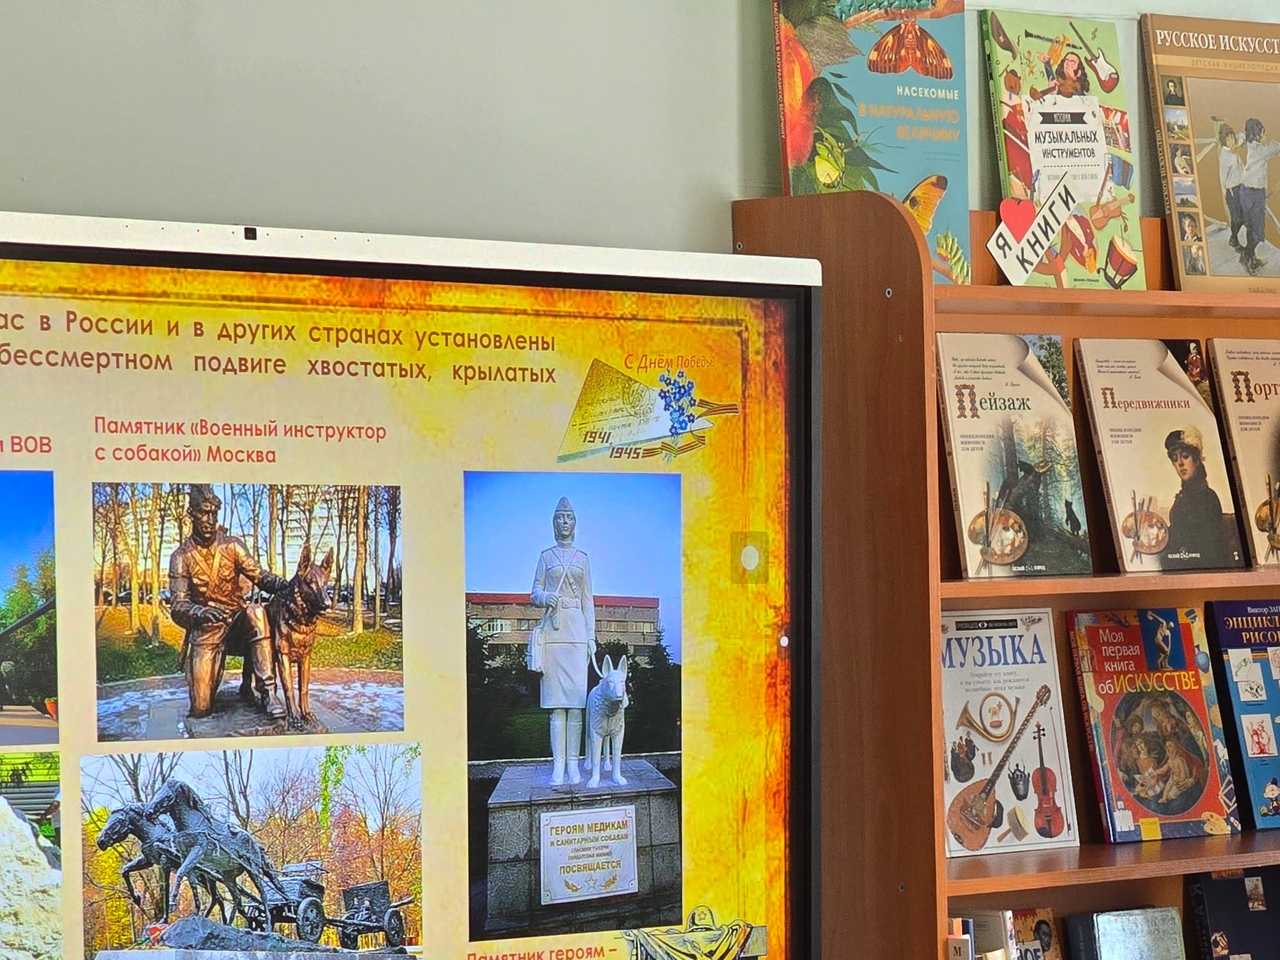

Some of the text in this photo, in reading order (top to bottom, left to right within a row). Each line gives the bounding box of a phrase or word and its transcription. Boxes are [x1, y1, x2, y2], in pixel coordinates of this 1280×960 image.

[1154, 29, 1217, 50] РУССКОЕ
[1191, 59, 1279, 72] ДЕТСКАЯ ЭНЦИКЛОПЕДИЯ
[896, 85, 959, 100] НАСЕКОМЫЕ
[1034, 130, 1099, 144] МУЗЫКАЛЬНЫХ
[1041, 148, 1096, 159] ИНСТРУМЕНТОВ
[995, 183, 1077, 275] Я КНИГИ
[39, 314, 51, 332] в
[65, 309, 154, 336] России
[166, 319, 180, 337] и
[193, 320, 205, 338] в
[217, 321, 297, 345] других
[308, 324, 404, 348] странах
[415, 329, 555, 351] установлены
[0, 342, 557, 385] бессмертном подвиге хвостатых, крылатых
[623, 354, 635, 370] С
[636, 353, 673, 374] Днём
[954, 383, 1032, 419] Пейзаж
[1100, 386, 1191, 412] Передвижники
[94, 416, 387, 443] Памятник «Военный инструктор
[10, 435, 53, 454] ВОВ
[94, 444, 277, 463] с собакой» Москва
[608, 447, 643, 459] 1945
[1099, 628, 1124, 643] Моя
[941, 633, 1047, 669] МУЗЫКА
[1102, 645, 1140, 659] первая
[1104, 660, 1135, 672] книга
[1098, 670, 1200, 694] об ИСКУССТВЕ
[549, 819, 628, 836] ГЕРОЯМ МЕДИКАМ
[559, 860, 622, 875] ПОСВЯЩАЕТСЯ
